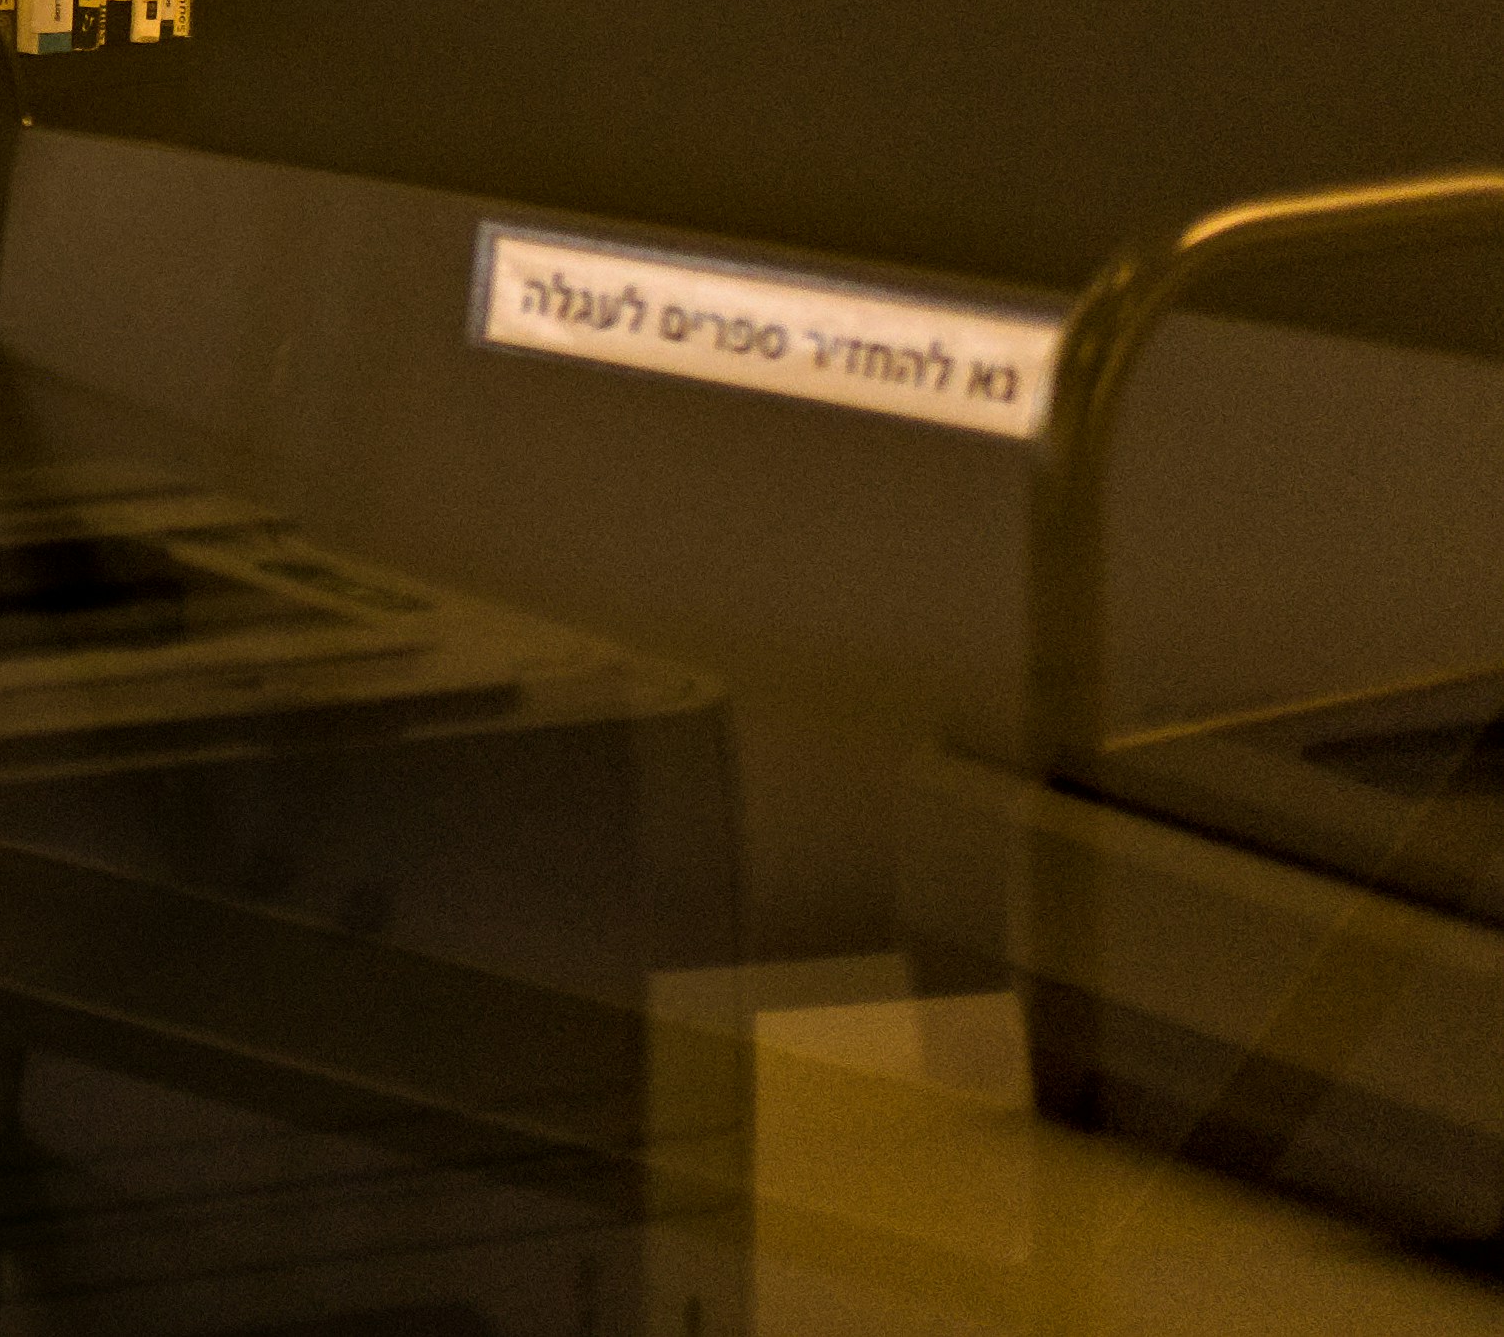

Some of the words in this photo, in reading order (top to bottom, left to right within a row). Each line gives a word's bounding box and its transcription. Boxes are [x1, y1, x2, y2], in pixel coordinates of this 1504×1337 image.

[519, 269, 648, 334] לעגלה
[658, 300, 789, 361] ספרים
[805, 326, 958, 392] להחזיר
[966, 360, 1020, 405] נא
